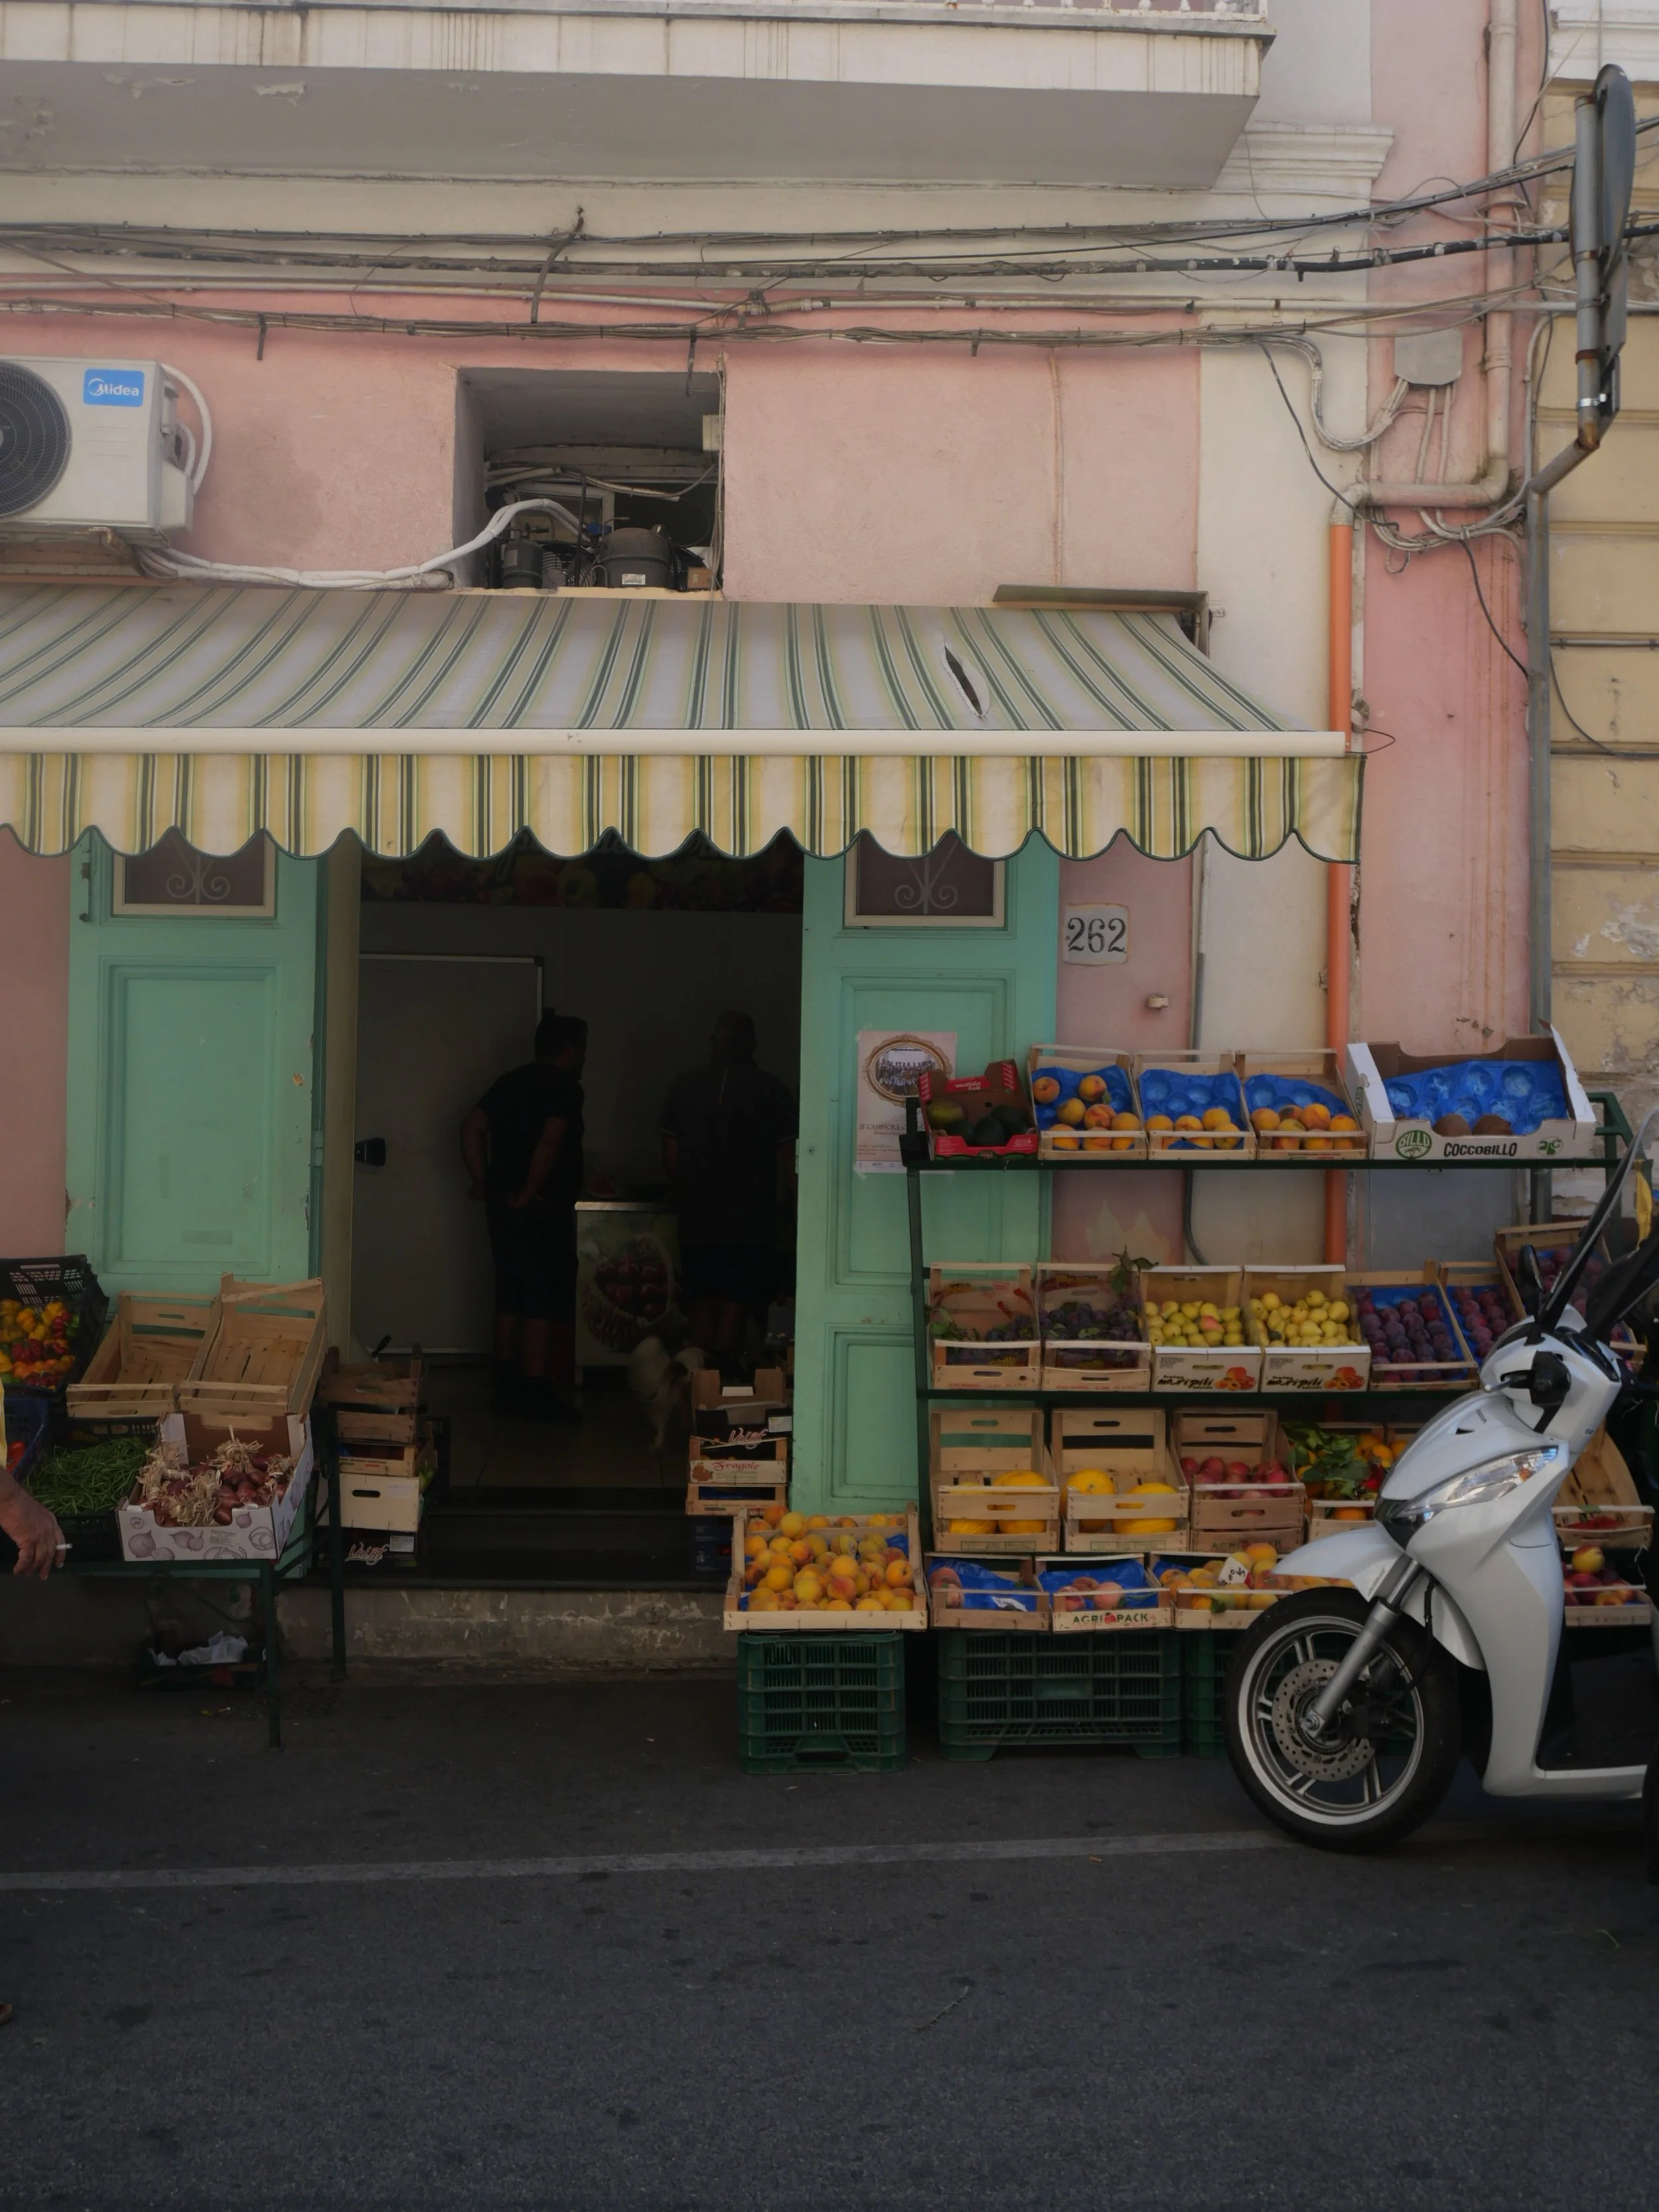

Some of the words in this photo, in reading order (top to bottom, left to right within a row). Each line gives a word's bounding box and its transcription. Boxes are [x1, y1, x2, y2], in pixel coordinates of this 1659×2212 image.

[90, 380, 139, 396] Midea
[1067, 917, 1126, 953] 262
[1398, 1132, 1430, 1148] BILLO
[1443, 1142, 1518, 1157] COCCOBILLO
[1157, 1377, 1214, 1389] maripili
[1266, 1377, 1323, 1389] maripili
[712, 1461, 760, 1471] Fragole
[1073, 1615, 1103, 1623] AGRI
[1116, 1613, 1149, 1623] PACK
